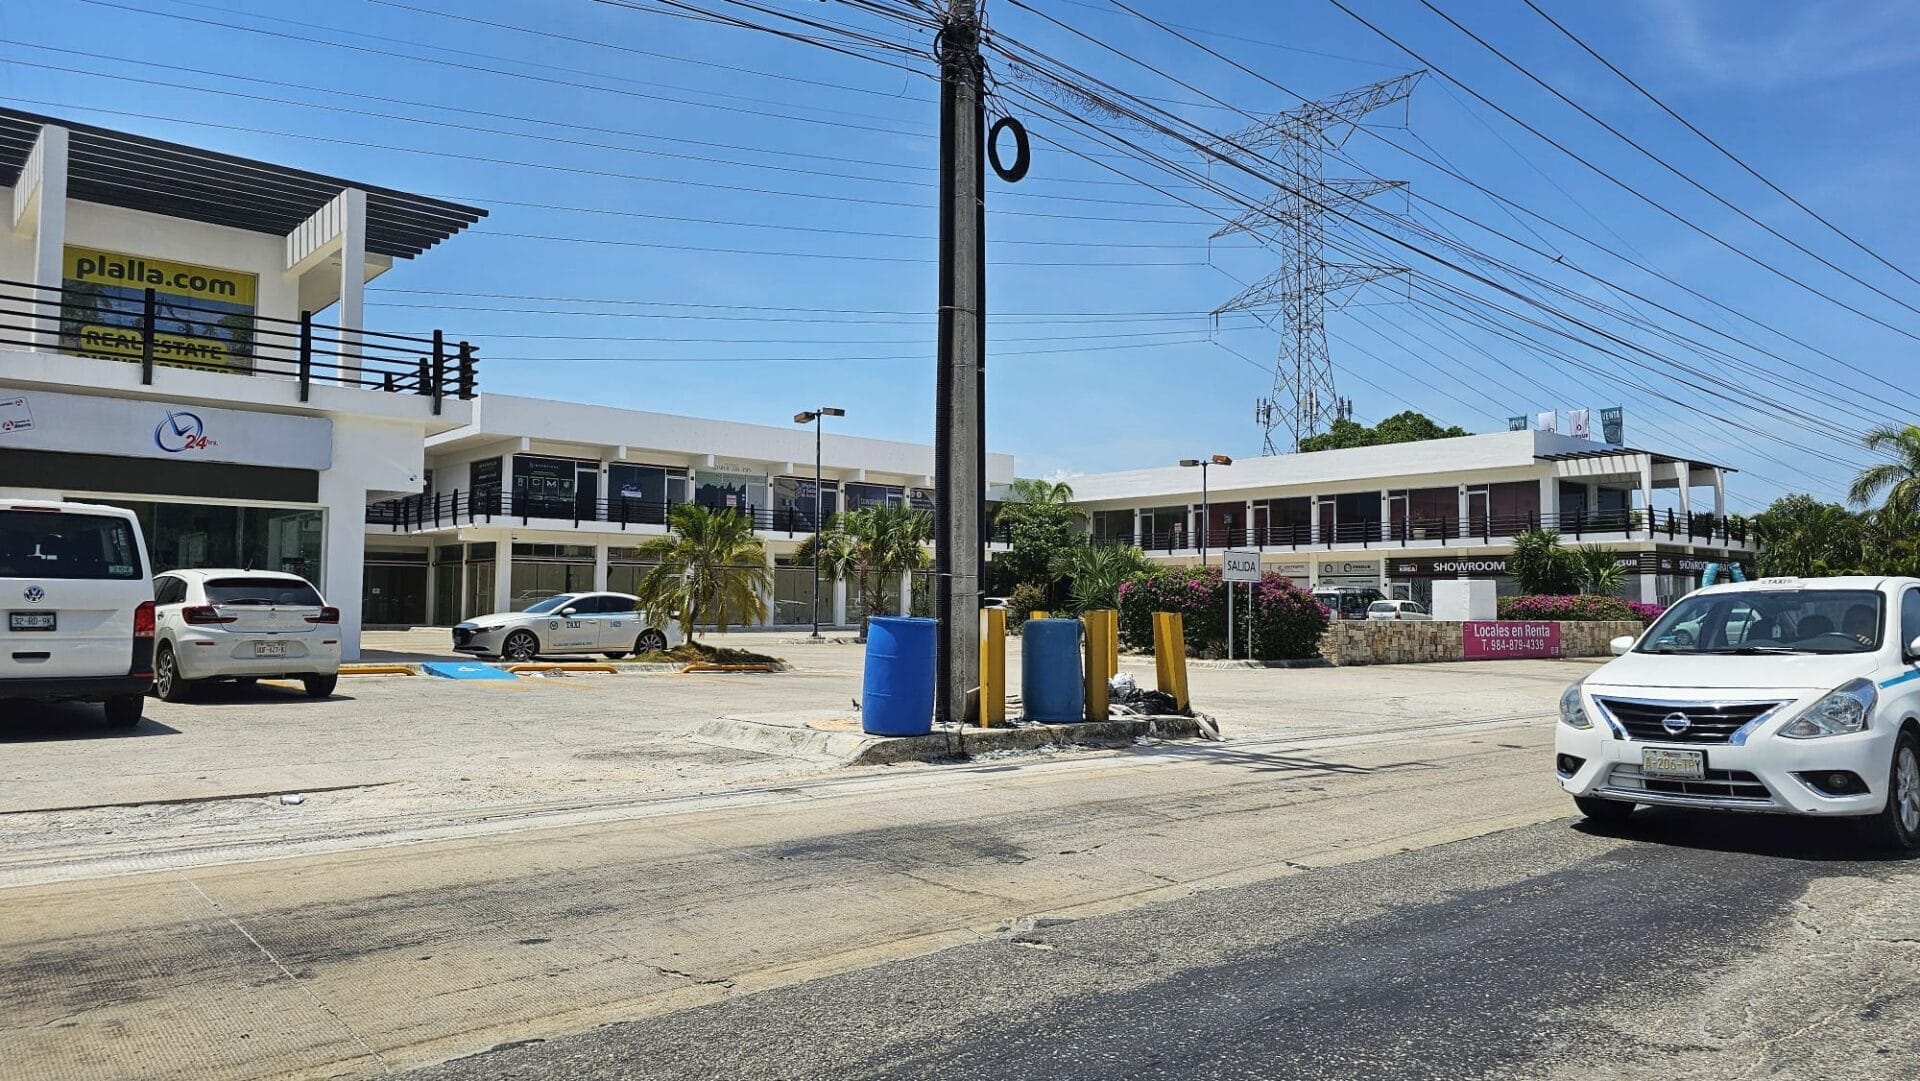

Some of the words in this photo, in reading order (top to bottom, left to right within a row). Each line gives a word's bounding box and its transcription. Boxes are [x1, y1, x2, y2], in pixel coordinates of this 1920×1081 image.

[76, 255, 235, 296] plalla.com
[86, 330, 143, 351] REAL
[152, 339, 222, 361] ESTATE
[1227, 560, 1256, 573] SALIDA
[1433, 561, 1506, 572] SHOWROOM
[1679, 560, 1708, 571] SHOWROO
[566, 620, 581, 629] TAXI
[1474, 623, 1510, 638] Locales
[1512, 626, 1523, 637] en
[1525, 624, 1551, 638] Renta
[1481, 639, 1489, 651] T.
[1491, 639, 1545, 651] 984-879-4339
